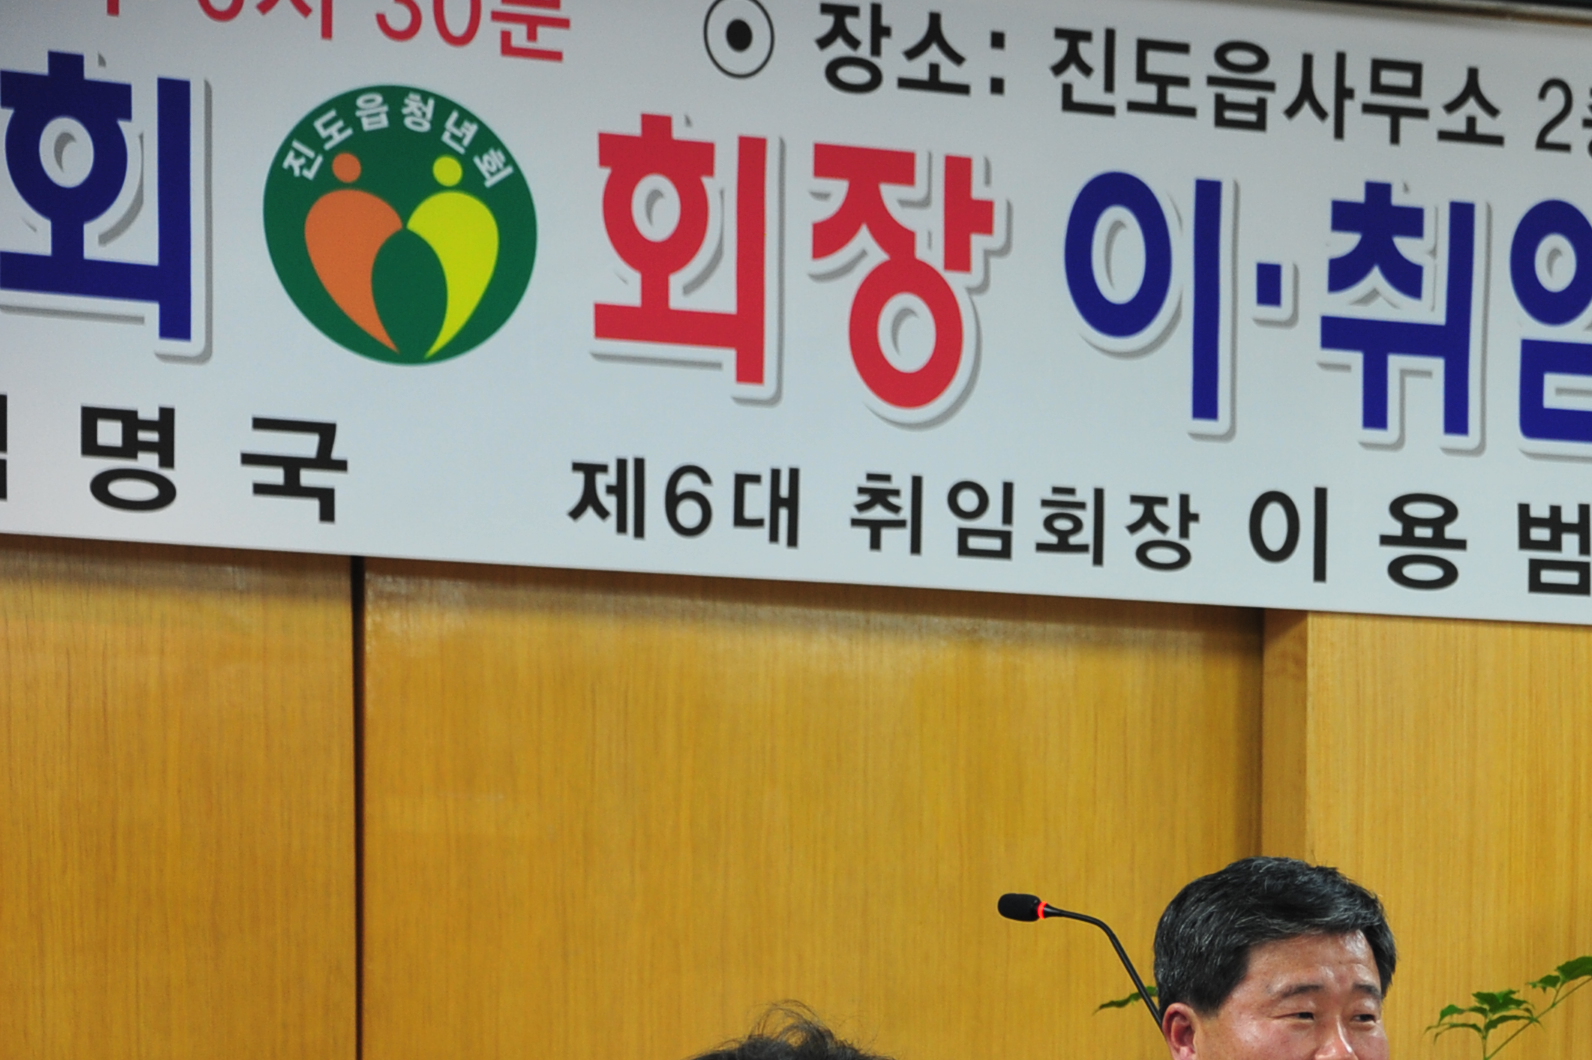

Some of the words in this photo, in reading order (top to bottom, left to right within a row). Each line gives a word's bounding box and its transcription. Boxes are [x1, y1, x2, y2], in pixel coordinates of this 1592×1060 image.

[814, 2, 1006, 96] 장소:
[1050, 26, 1506, 147] 진도읍사무소
[282, 92, 515, 188] 진도읍청년회
[594, 113, 995, 410] 회장
[568, 457, 801, 549] 제6대
[850, 473, 1200, 571] 취임회장
